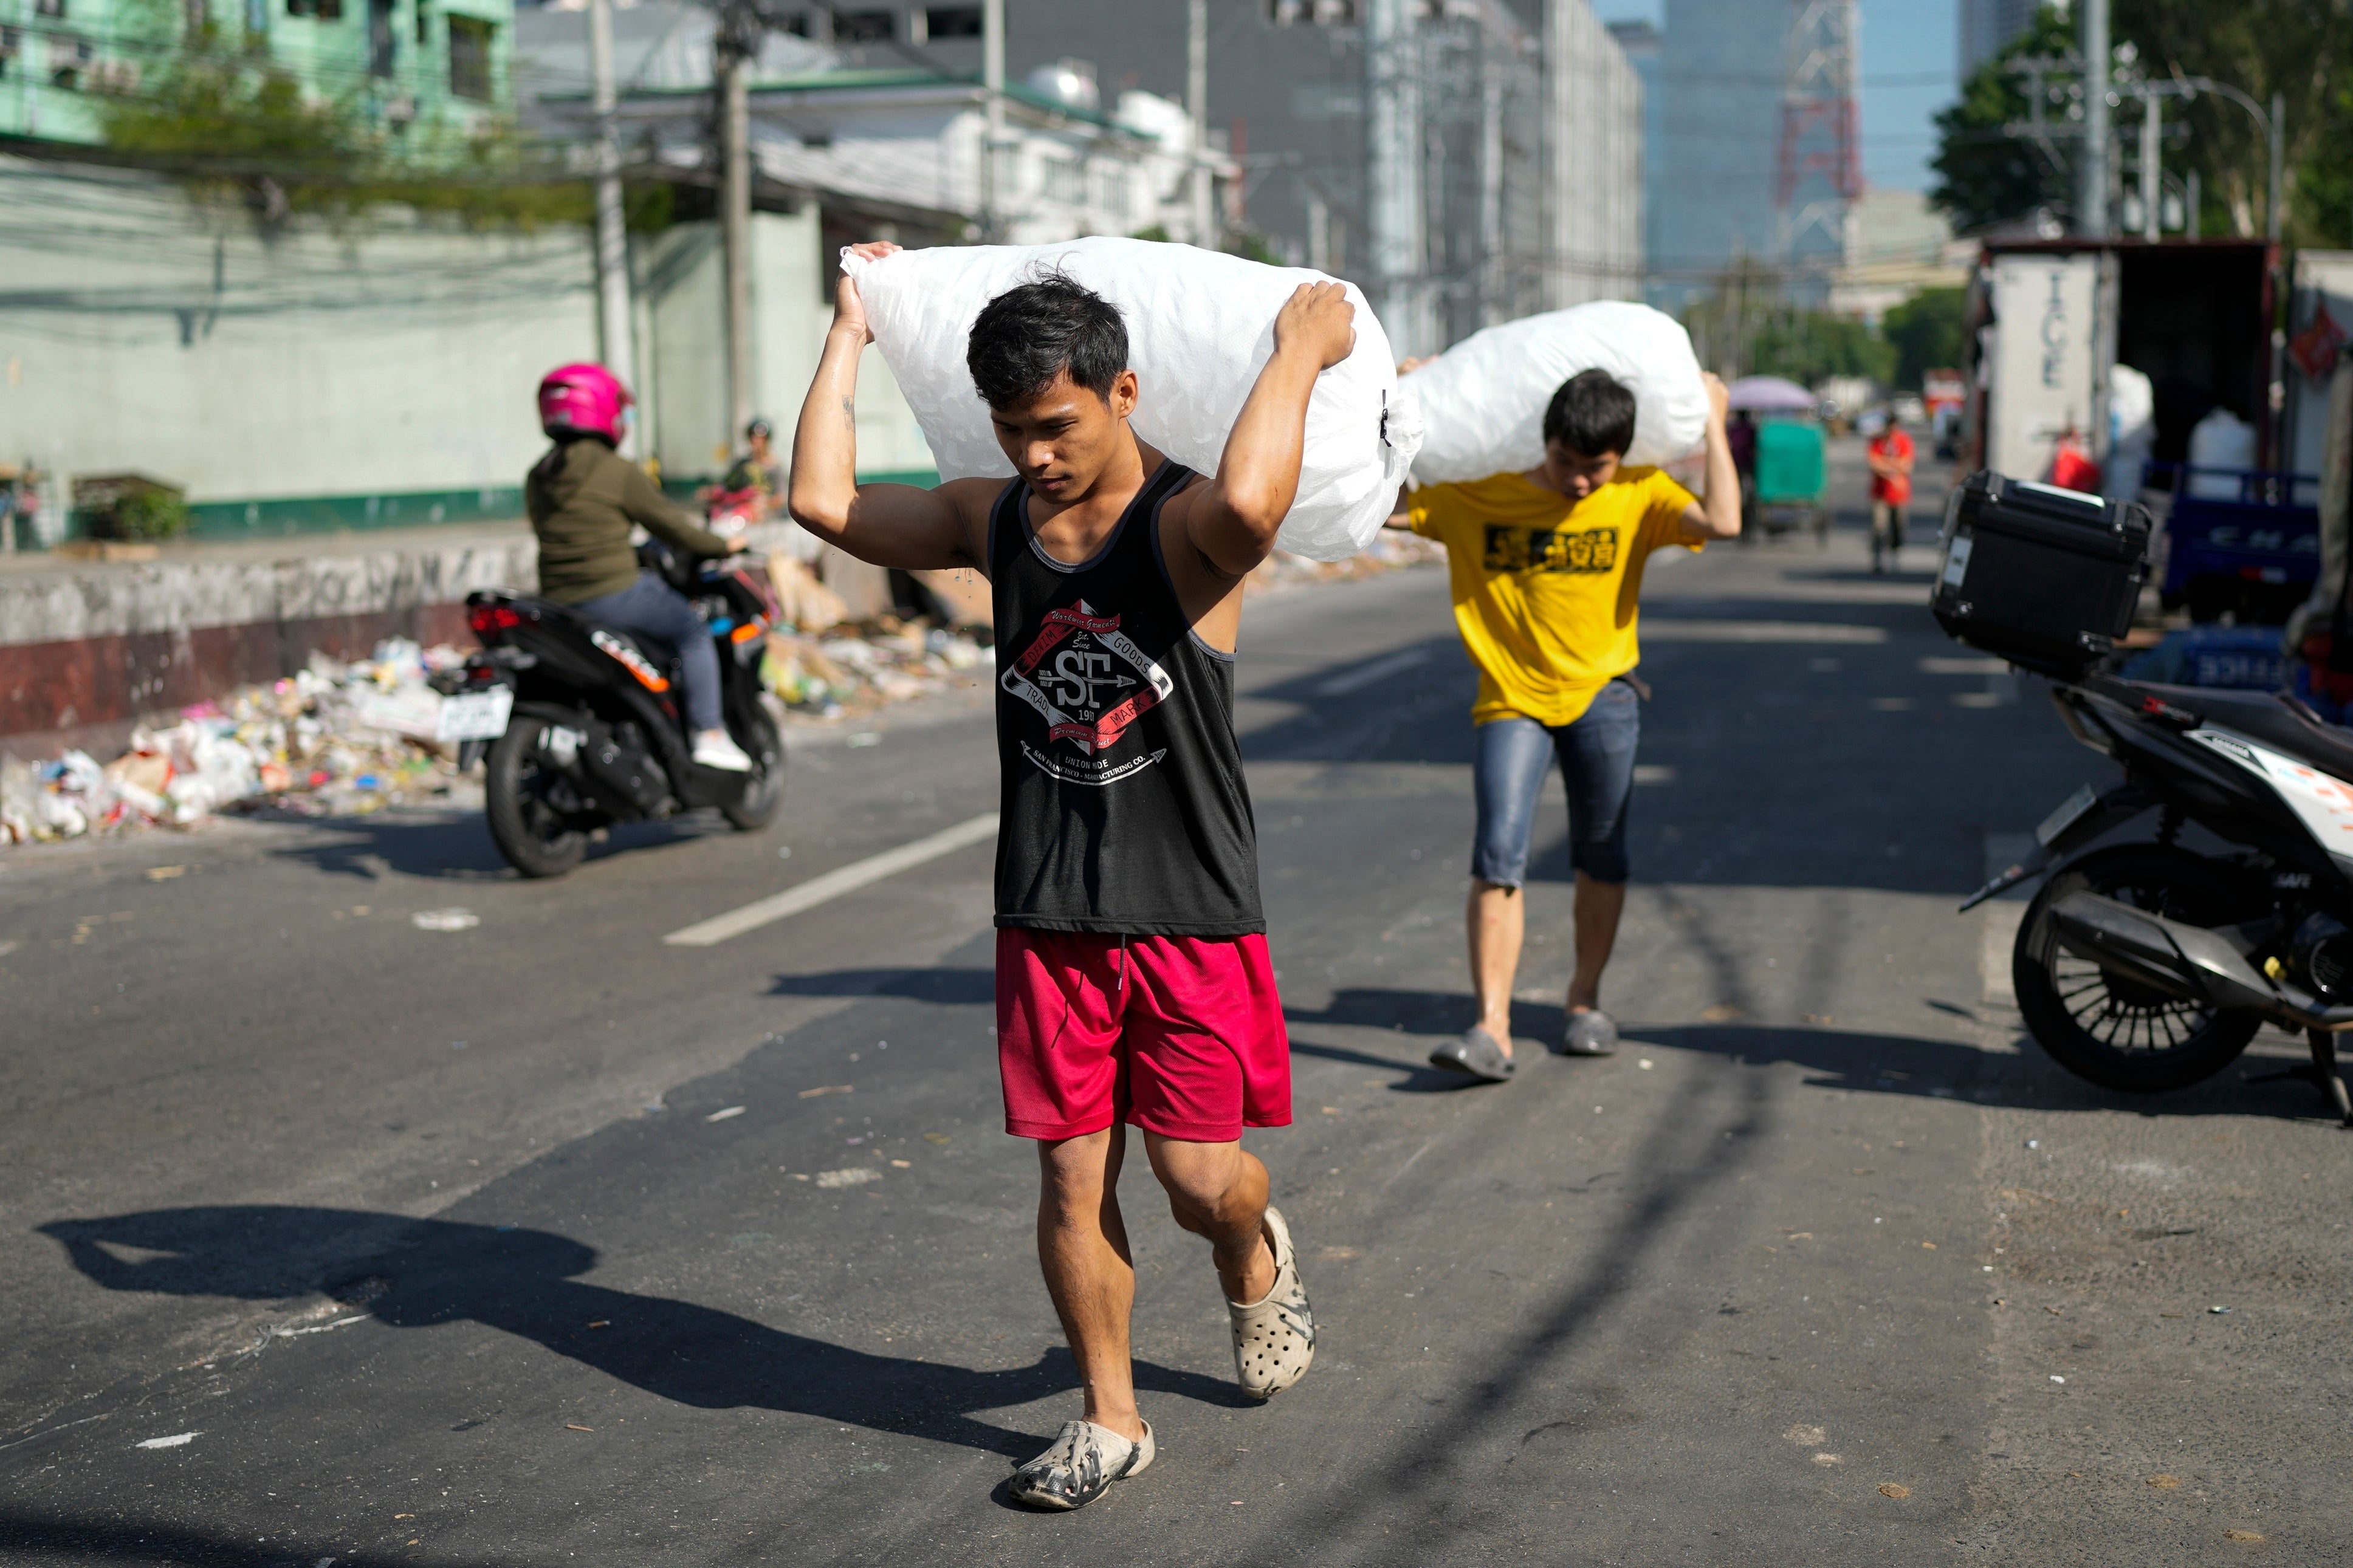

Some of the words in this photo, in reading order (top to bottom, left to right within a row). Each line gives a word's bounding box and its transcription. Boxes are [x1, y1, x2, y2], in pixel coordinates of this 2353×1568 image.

[2041, 270, 2069, 388] ICE
[1077, 631, 1089, 640] Est.
[1087, 618, 1116, 630] Garments
[1027, 629, 1058, 662] DENIM
[1072, 639, 1090, 650] Since
[1113, 637, 1151, 675] GOODS
[1055, 649, 1111, 708] SF
[1110, 697, 1147, 726] MARK
[1054, 727, 1088, 737] Premium
[1033, 750, 1047, 762] SAN
[1046, 758, 1079, 778] FRANCISCO
[1133, 755, 1146, 765] CO.
[1065, 756, 1091, 769] UNION
